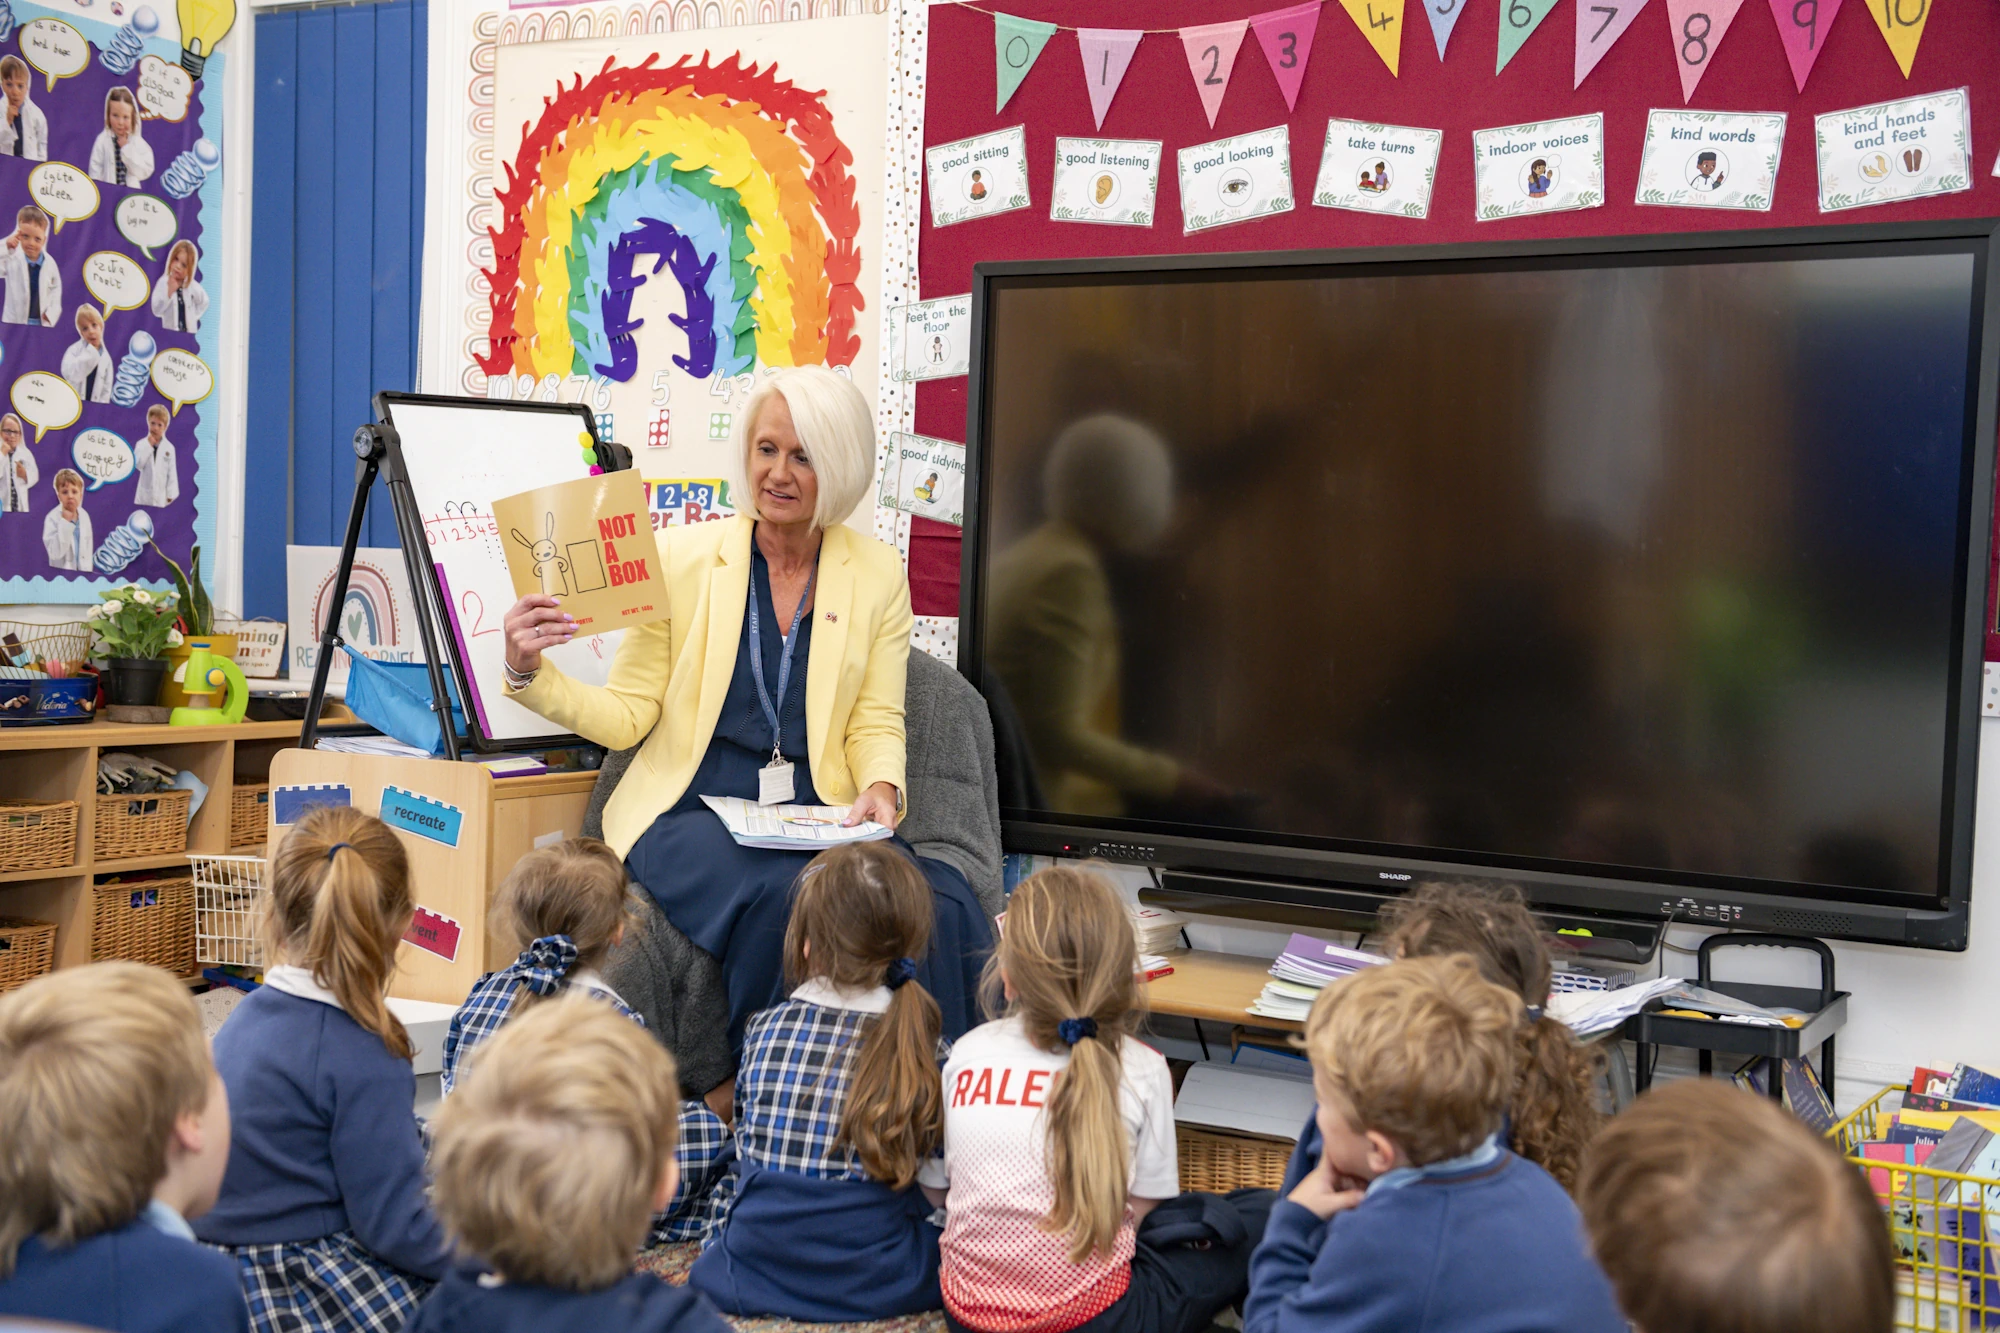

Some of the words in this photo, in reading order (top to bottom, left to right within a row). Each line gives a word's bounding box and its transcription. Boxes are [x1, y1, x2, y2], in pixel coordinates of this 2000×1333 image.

[1005, 35, 1030, 69] 0
[1101, 49, 1110, 86] 1
[1201, 44, 1224, 86] 2
[1277, 31, 1298, 69] 3
[1366, 3, 1395, 32] 4
[1507, 0, 1532, 29] 6
[1590, 6, 1618, 44] 7
[1681, 13, 1712, 66] 8
[1792, 0, 1819, 51] 9
[1884, 0, 1927, 30] 10
[1844, 116, 1878, 136] kind
[1886, 107, 1936, 128] hands
[1348, 136, 1376, 150] take
[1381, 142, 1415, 155] turns
[1489, 141, 1537, 157] indoor
[1543, 134, 1589, 150] voices
[1671, 127, 1701, 141] kind
[1709, 128, 1756, 143] words
[1854, 131, 1885, 150] and
[1892, 126, 1927, 143] feet
[941, 153, 969, 173] good
[973, 146, 1010, 162] sitting
[1066, 152, 1096, 166] good
[1100, 154, 1150, 170] listening
[1193, 152, 1224, 174] good
[1229, 145, 1274, 164] looking
[906, 311, 928, 323] feet
[932, 310, 945, 320] on
[949, 305, 967, 317] the
[923, 321, 950, 334] floor
[540, 372, 562, 402] 8
[569, 374, 592, 404] 7
[592, 374, 612, 412] 6
[651, 369, 671, 407] 5
[710, 367, 734, 405] 4
[901, 446, 929, 462] good
[932, 453, 966, 474] tidying
[663, 486, 676, 506] 2
[696, 486, 709, 508] 8
[451, 527, 466, 541] 2
[464, 525, 477, 540] 3
[477, 524, 487, 537] 4
[487, 522, 500, 536] 5
[597, 512, 637, 542] NOT
[604, 541, 620, 565] A
[607, 558, 651, 588] BOX
[461, 589, 502, 638] 2
[228, 628, 279, 646] ming
[394, 804, 447, 832] recreate
[1379, 872, 1412, 881] SHARP
[410, 921, 439, 942] vent
[951, 1067, 1061, 1108] RALE
